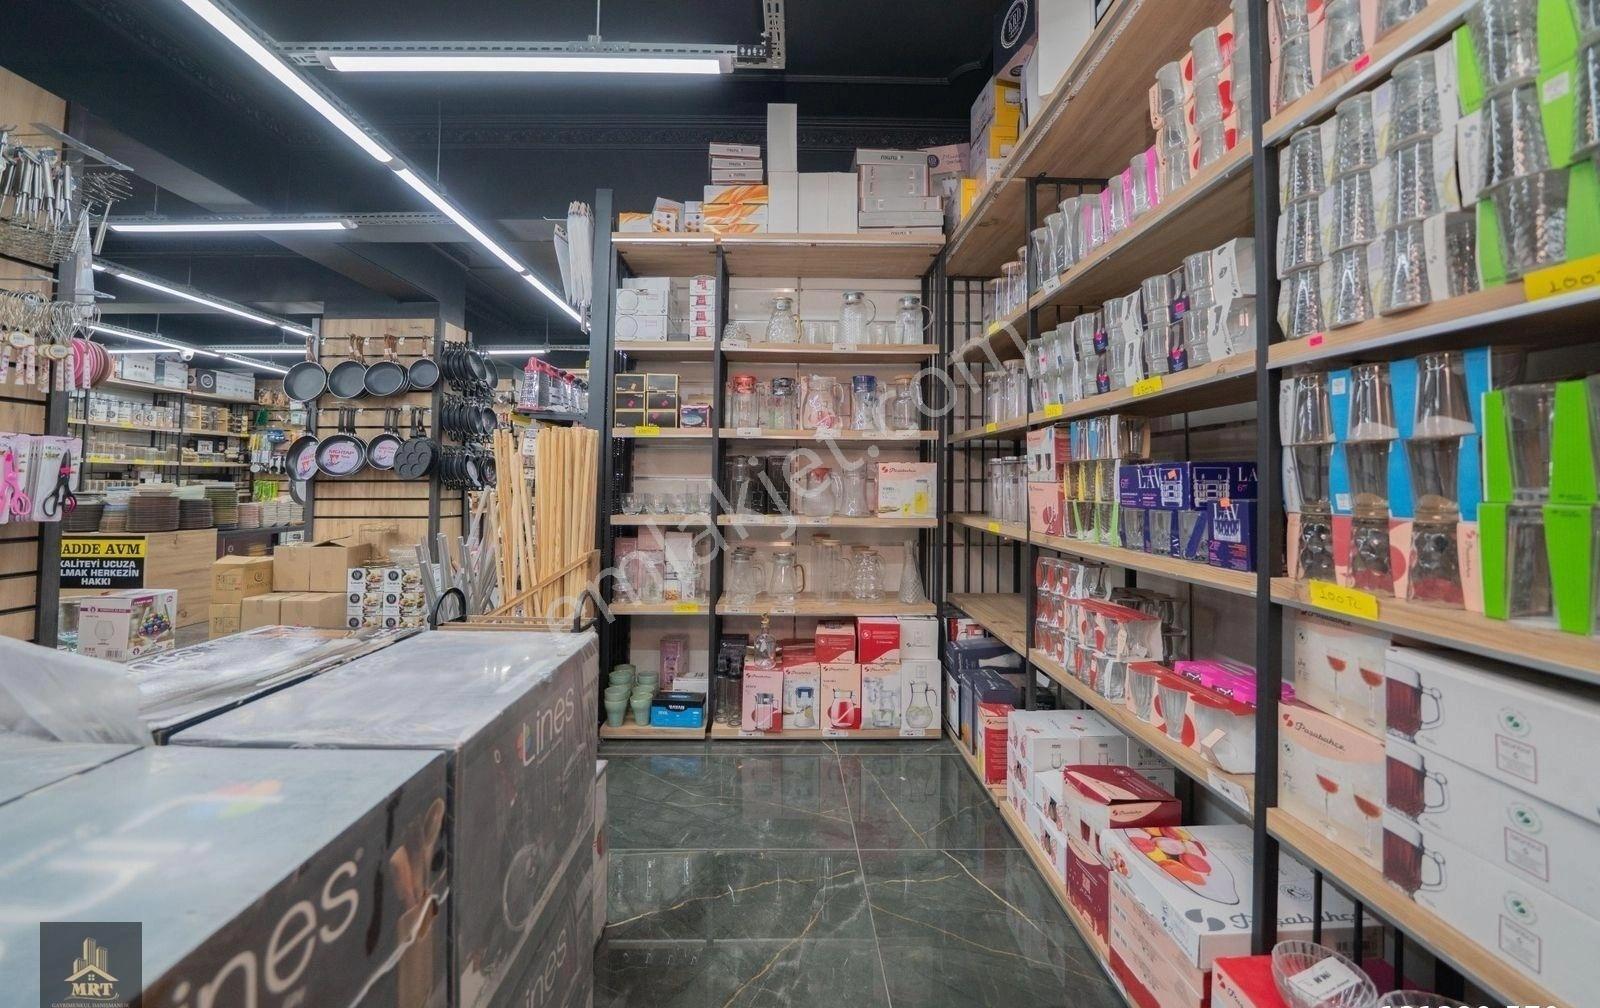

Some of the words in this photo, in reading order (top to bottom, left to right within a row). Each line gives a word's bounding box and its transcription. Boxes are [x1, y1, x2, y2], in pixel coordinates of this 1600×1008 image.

[1549, 269, 1600, 293] 100
[1137, 468, 1162, 489] LAV
[1238, 467, 1257, 482] LA
[1213, 502, 1240, 521] LAV
[61, 543, 101, 555] ADDE
[105, 543, 141, 555] AVM
[102, 560, 136, 568] UCUZA
[60, 569, 88, 577] LMAK
[90, 568, 140, 577] HERKEZİN
[81, 578, 111, 586] HAKKI
[522, 687, 575, 768] Lines
